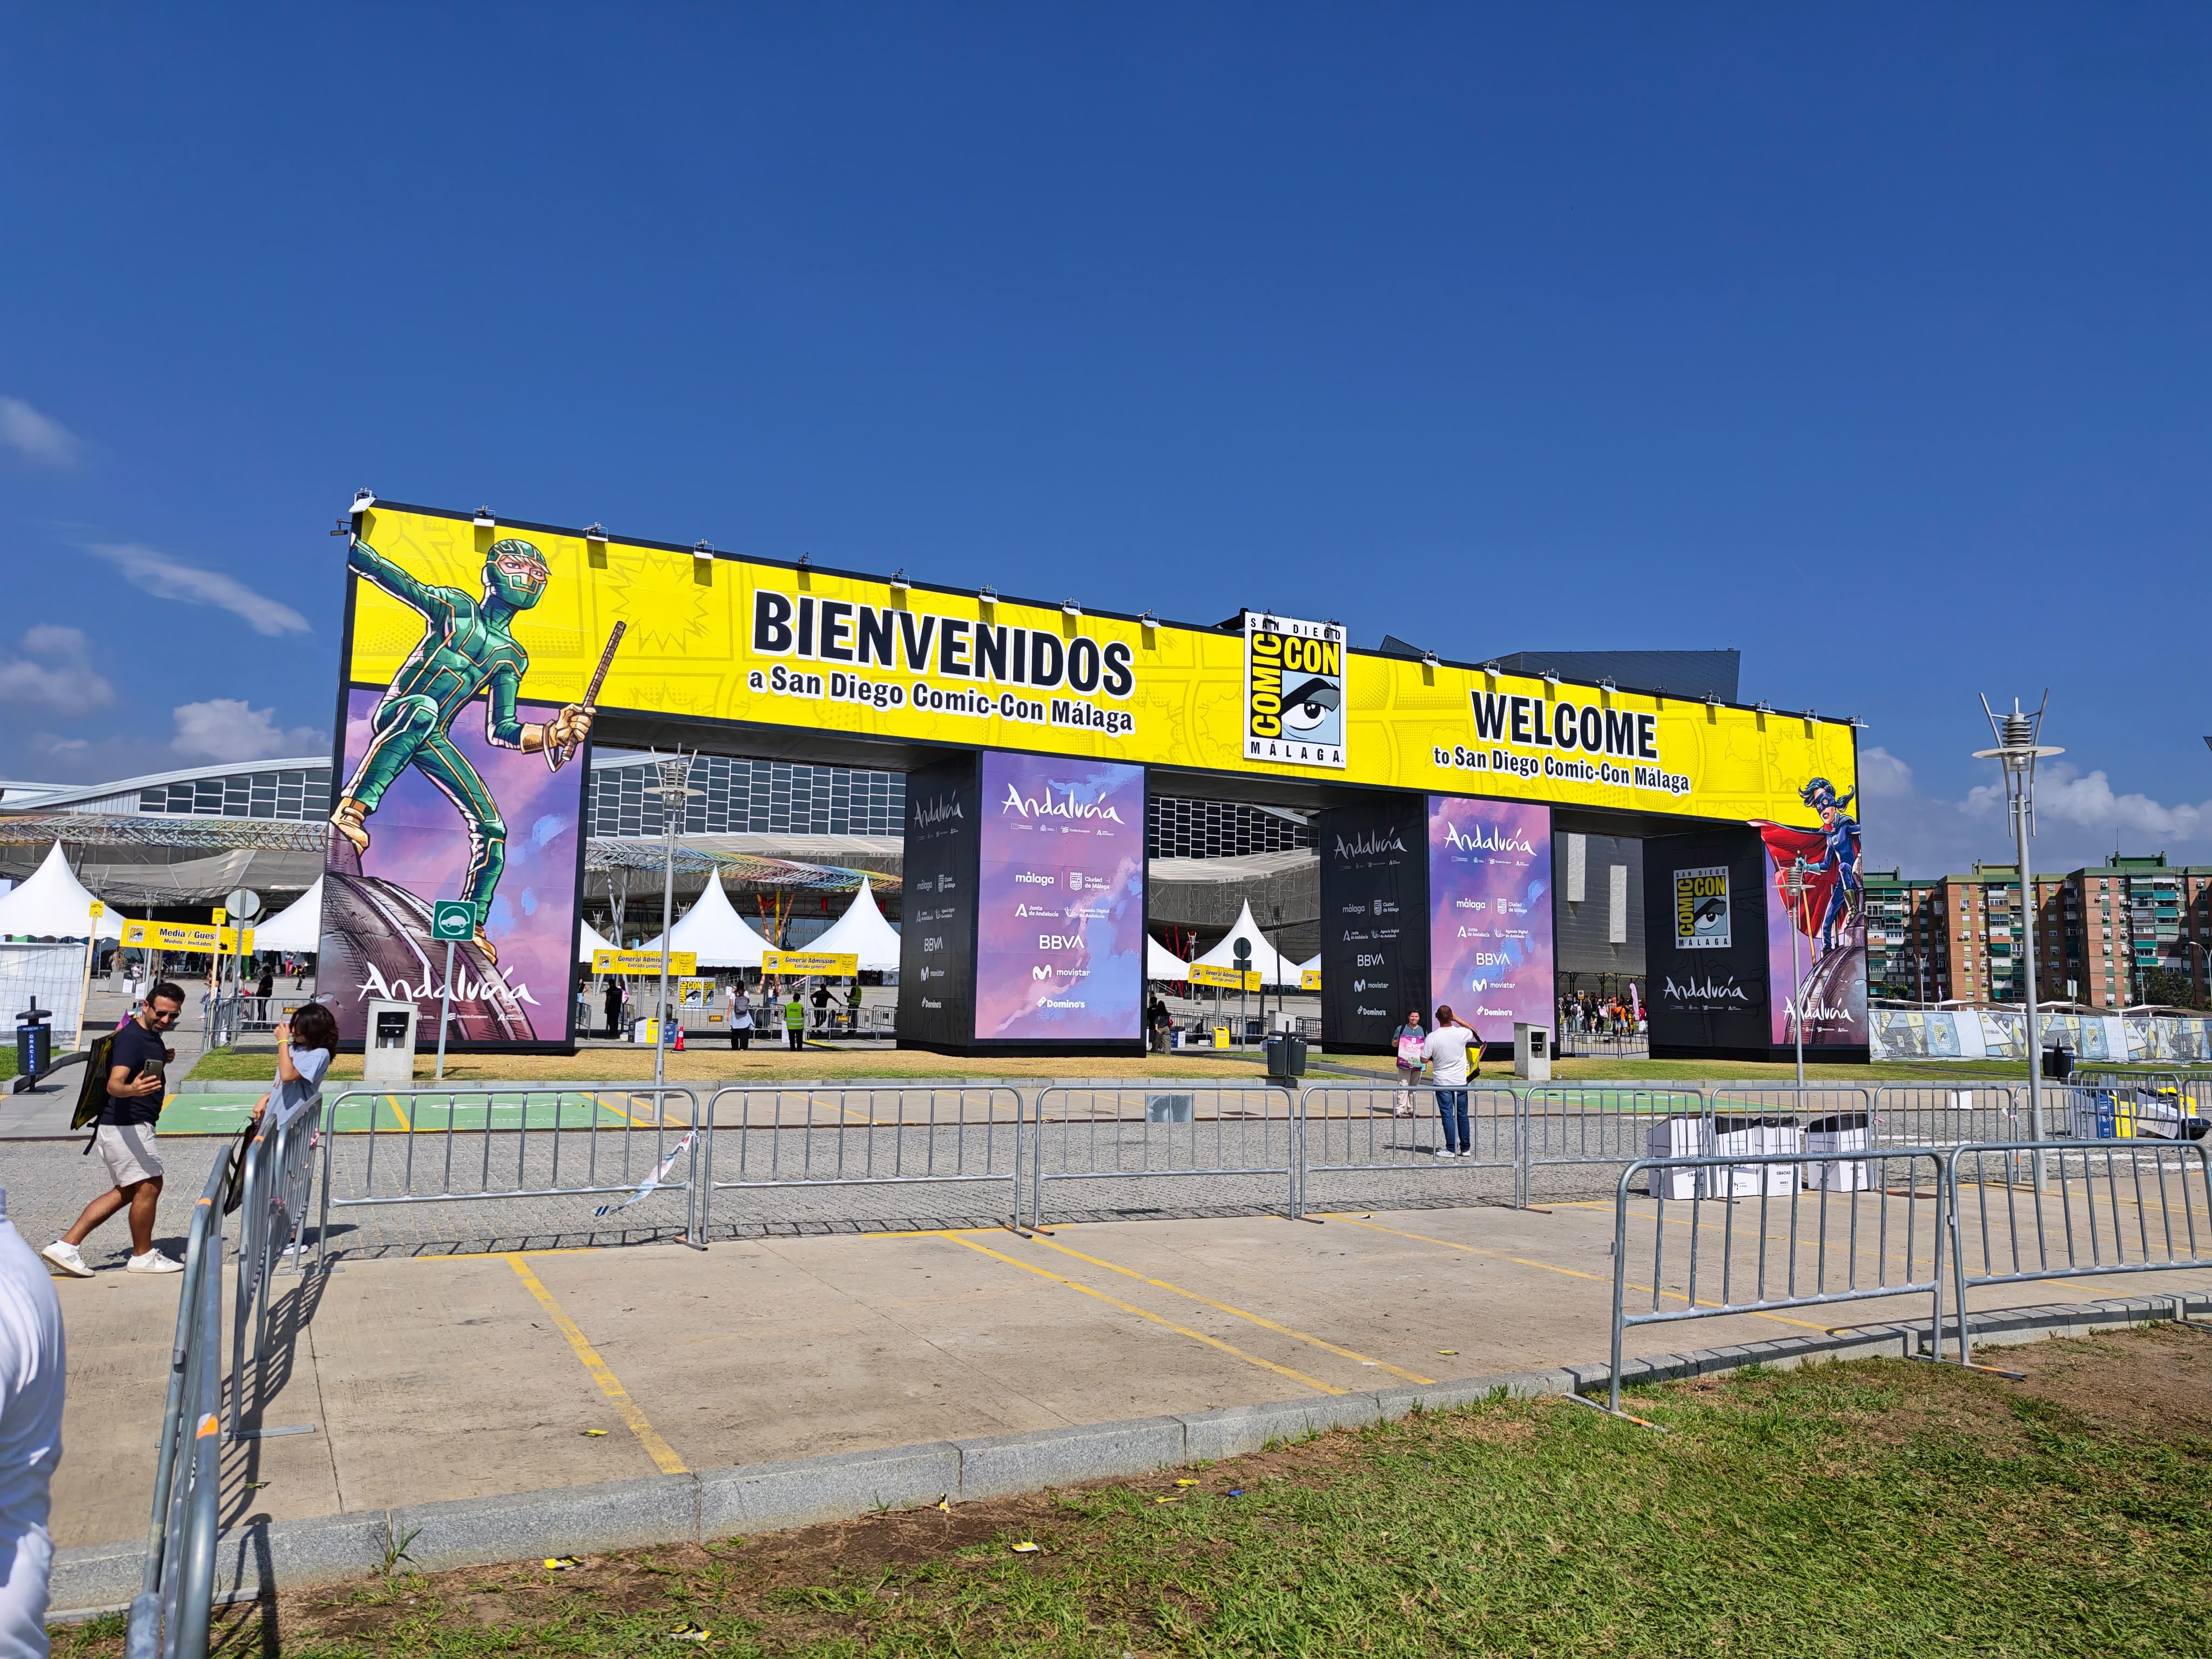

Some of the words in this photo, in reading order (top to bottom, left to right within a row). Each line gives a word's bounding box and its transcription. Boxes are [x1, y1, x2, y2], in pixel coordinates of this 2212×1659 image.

[1251, 618, 1279, 631] SAN
[1293, 624, 1340, 640] DIEGO
[756, 592, 1134, 696] BIENVENIDOS
[1284, 636, 1339, 676] CON
[1252, 633, 1282, 737] COMIC
[750, 671, 763, 689] a
[771, 666, 821, 695] San
[831, 672, 903, 707] Diego
[913, 683, 1043, 721] Comic-Con
[1051, 702, 1132, 733] Málaga
[1470, 691, 1658, 759] WELCOME
[1251, 740, 1340, 763] MÁLAGA
[1433, 747, 1449, 765] to
[1454, 746, 1487, 769] San
[1492, 751, 1539, 777] Diego
[1544, 756, 1629, 785] Comic-Con
[1634, 766, 1689, 793] Málaga
[1000, 783, 1126, 825] Andalucía
[1333, 825, 1408, 860] Andalucía
[1443, 821, 1538, 857] Andalucía
[1698, 868, 1726, 876] DIEGO
[1694, 876, 1725, 896] CON
[1677, 879, 1695, 936] COMIC
[159, 928, 186, 938] Media
[924, 936, 943, 952] BBVA
[1039, 934, 1085, 950] BBVA
[1678, 937, 1728, 947] MÁLAGA
[1357, 952, 1385, 967] BBVA
[1476, 952, 1510, 966] BBVA
[1056, 968, 1091, 976] movistar
[1223, 972, 1242, 980] Admissio
[355, 961, 542, 1006] Andalucía
[679, 981, 687, 1005] COMIC
[687, 981, 702, 989] CON
[1663, 975, 1749, 1001] Andalucía
[1047, 999, 1085, 1008] Domino's
[1363, 1008, 1386, 1016] Domino's
[1484, 1008, 1513, 1016] Domino's
